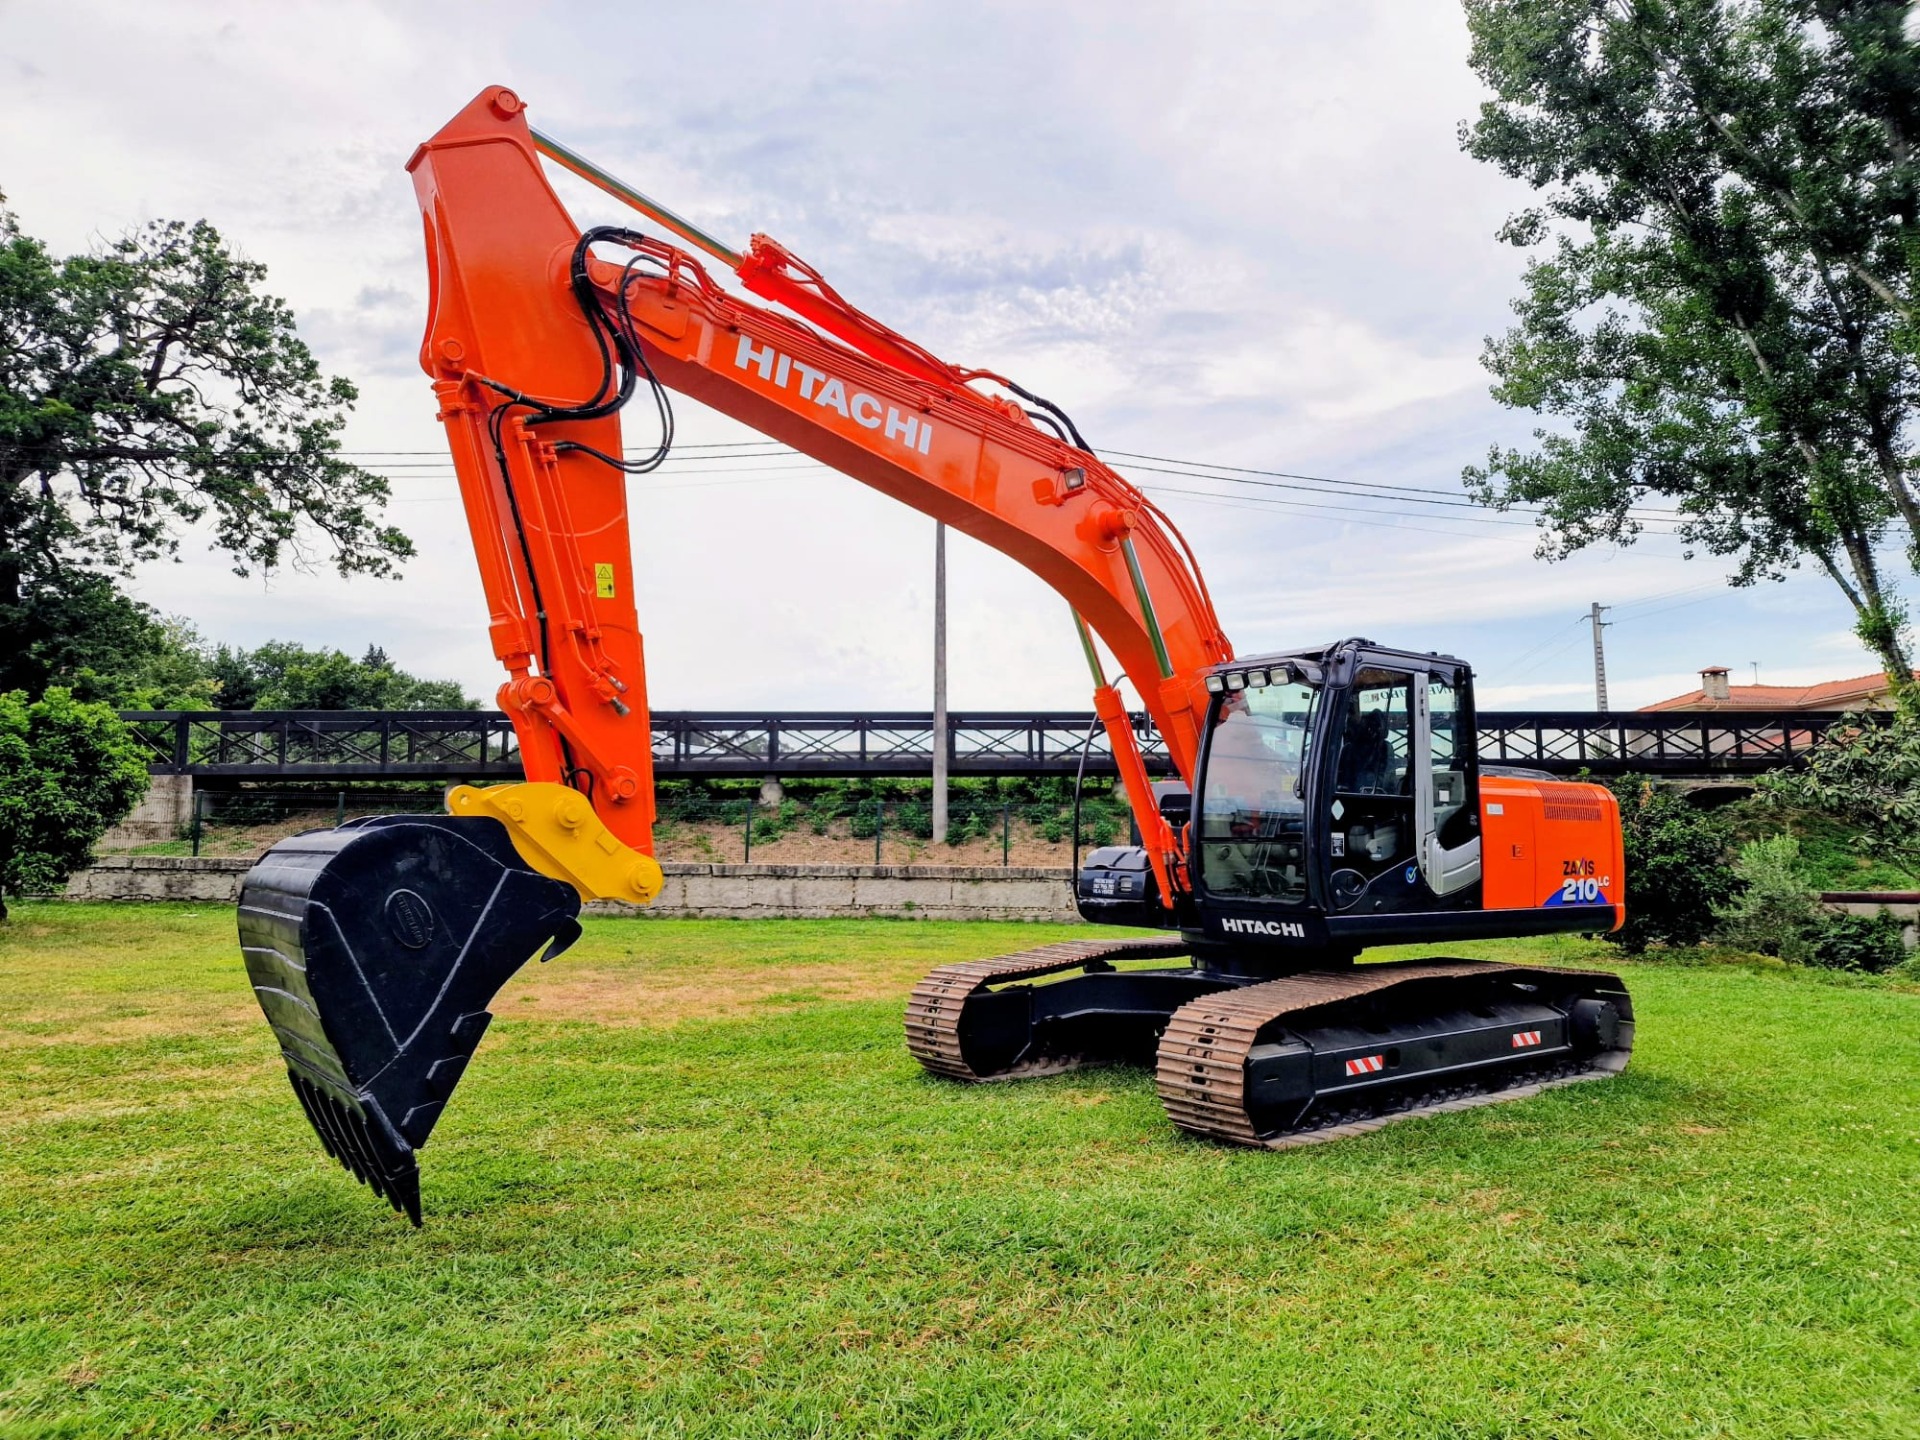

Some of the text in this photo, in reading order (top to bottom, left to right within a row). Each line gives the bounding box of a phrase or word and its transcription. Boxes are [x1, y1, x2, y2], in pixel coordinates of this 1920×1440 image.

[734, 334, 932, 455] HITACHI
[1562, 857, 1595, 876] ZAXIS
[1221, 917, 1305, 938] HITACHI
